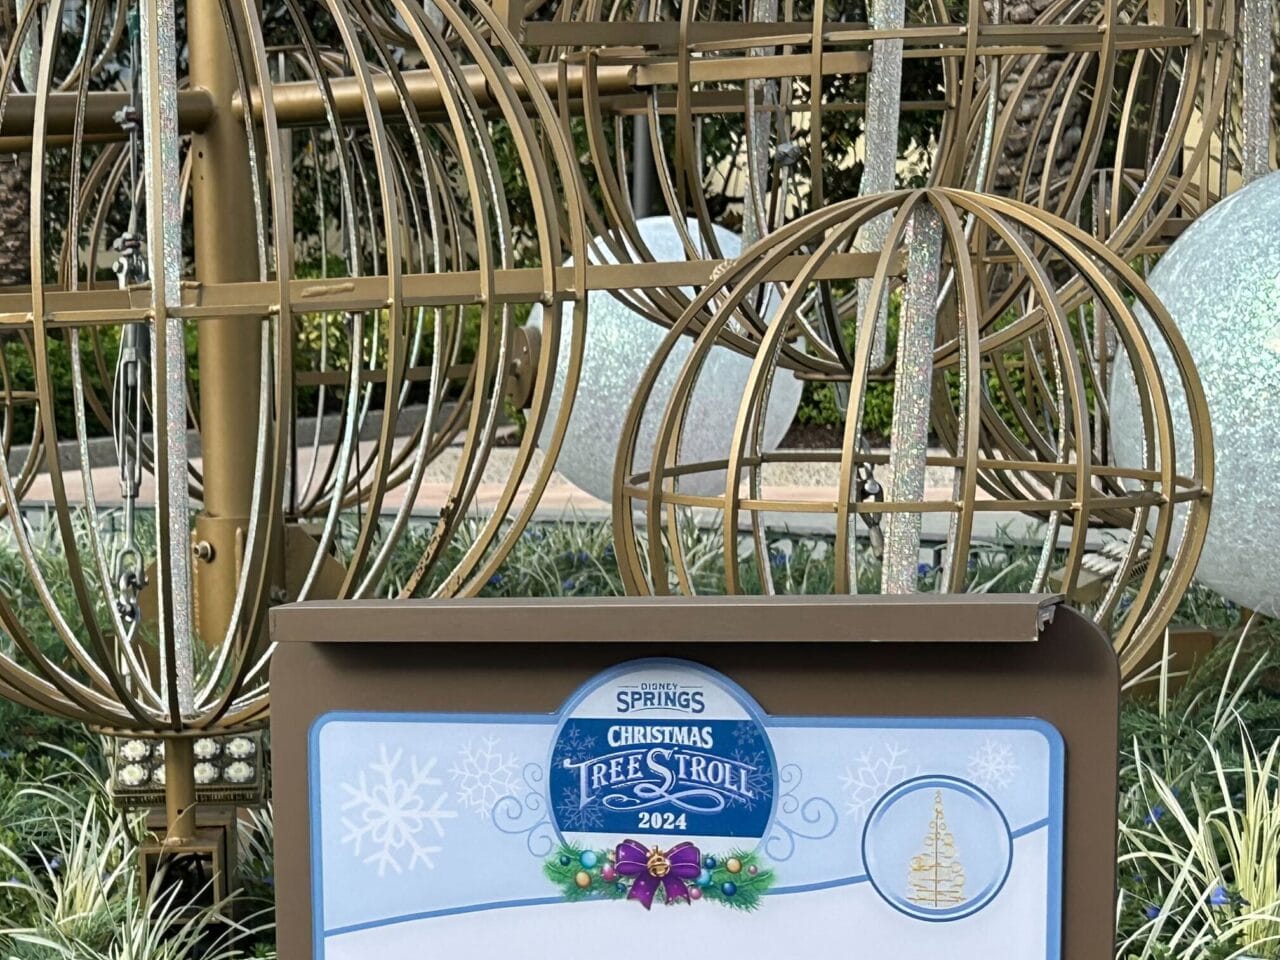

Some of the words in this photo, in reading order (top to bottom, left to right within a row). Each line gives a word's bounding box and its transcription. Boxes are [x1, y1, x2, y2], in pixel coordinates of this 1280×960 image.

[640, 682, 679, 691] DISNEY
[616, 691, 705, 713] SPRINGS
[607, 725, 713, 748] CHRISTMAS
[637, 811, 688, 830] 2024
